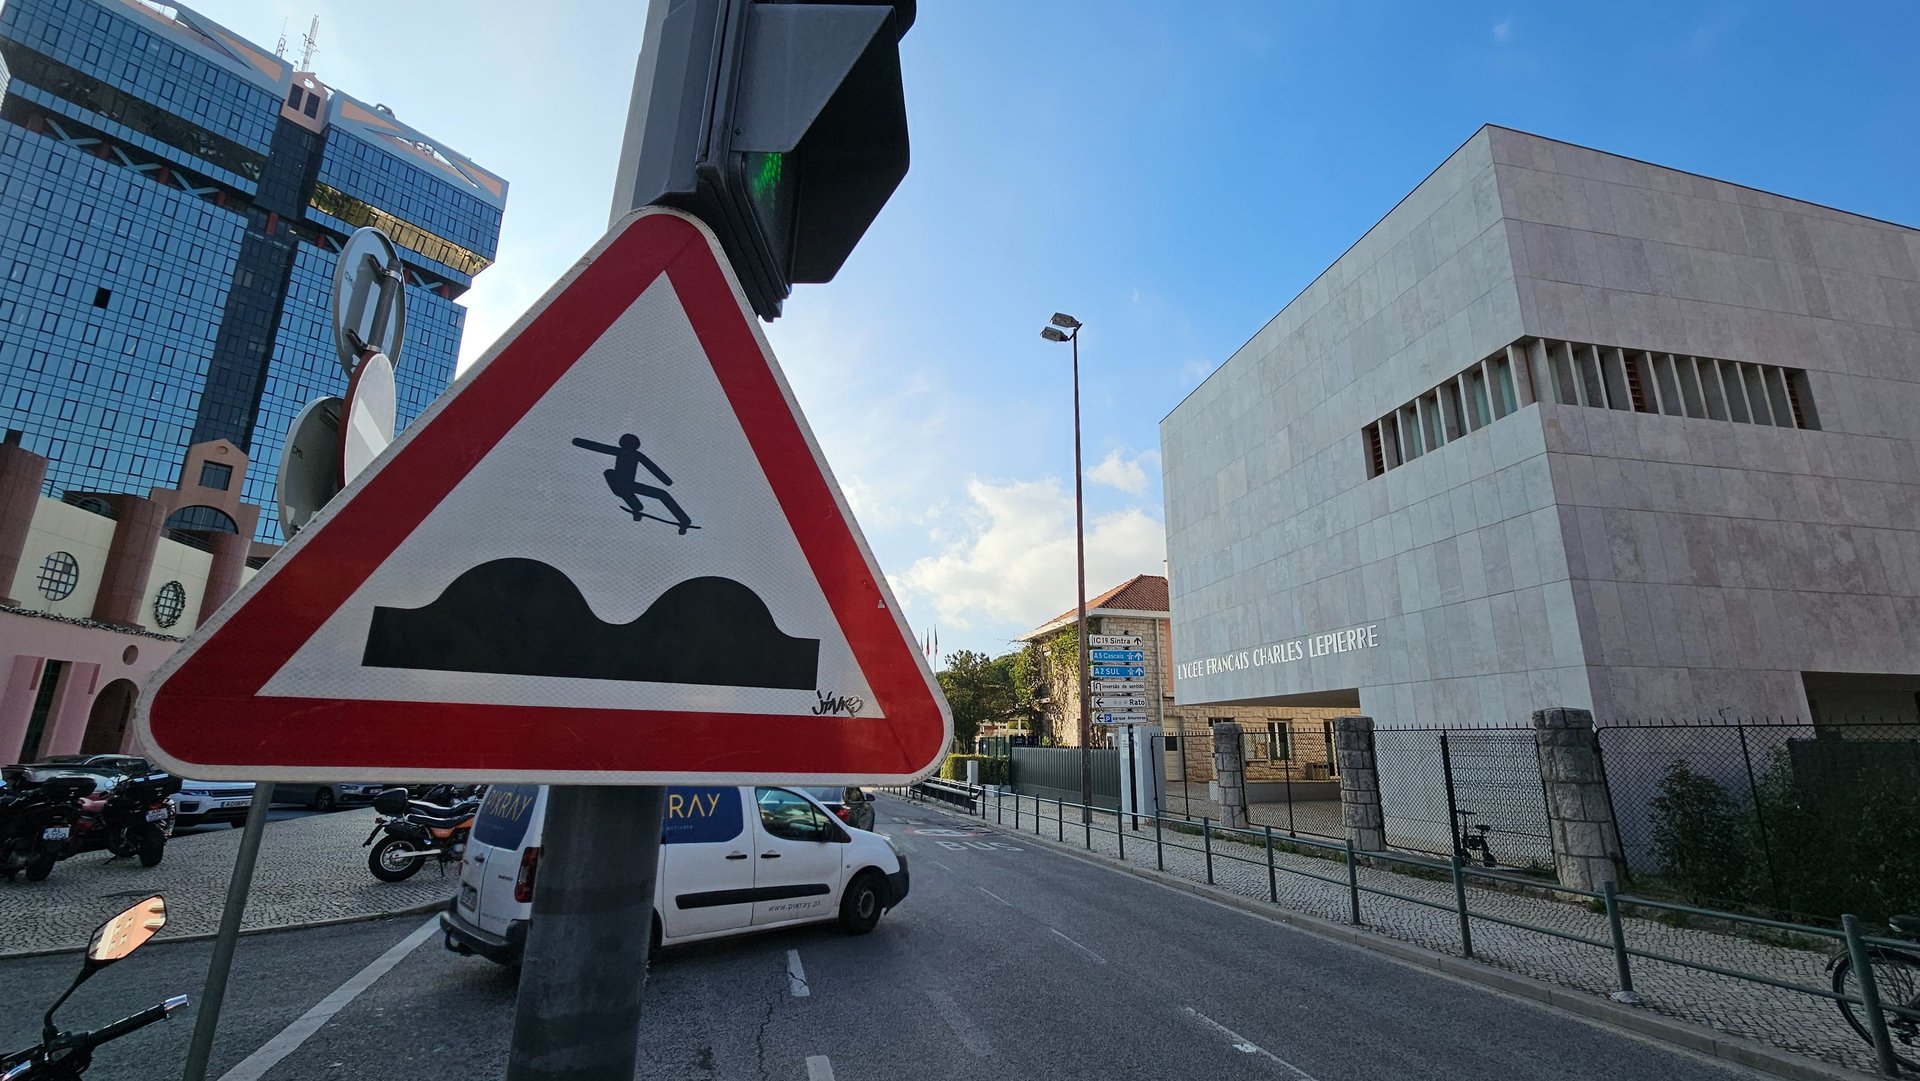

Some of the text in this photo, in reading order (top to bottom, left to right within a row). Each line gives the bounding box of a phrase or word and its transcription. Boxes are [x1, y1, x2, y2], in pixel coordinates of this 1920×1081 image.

[1110, 637, 1131, 645] Sintra
[1178, 624, 1379, 680] LYCÉE FRANÇAIS CHARLES LEPIERRE
[1095, 667, 1120, 675] A2 SUL
[482, 789, 533, 821] PIXRAY
[934, 841, 1024, 852] BUS
